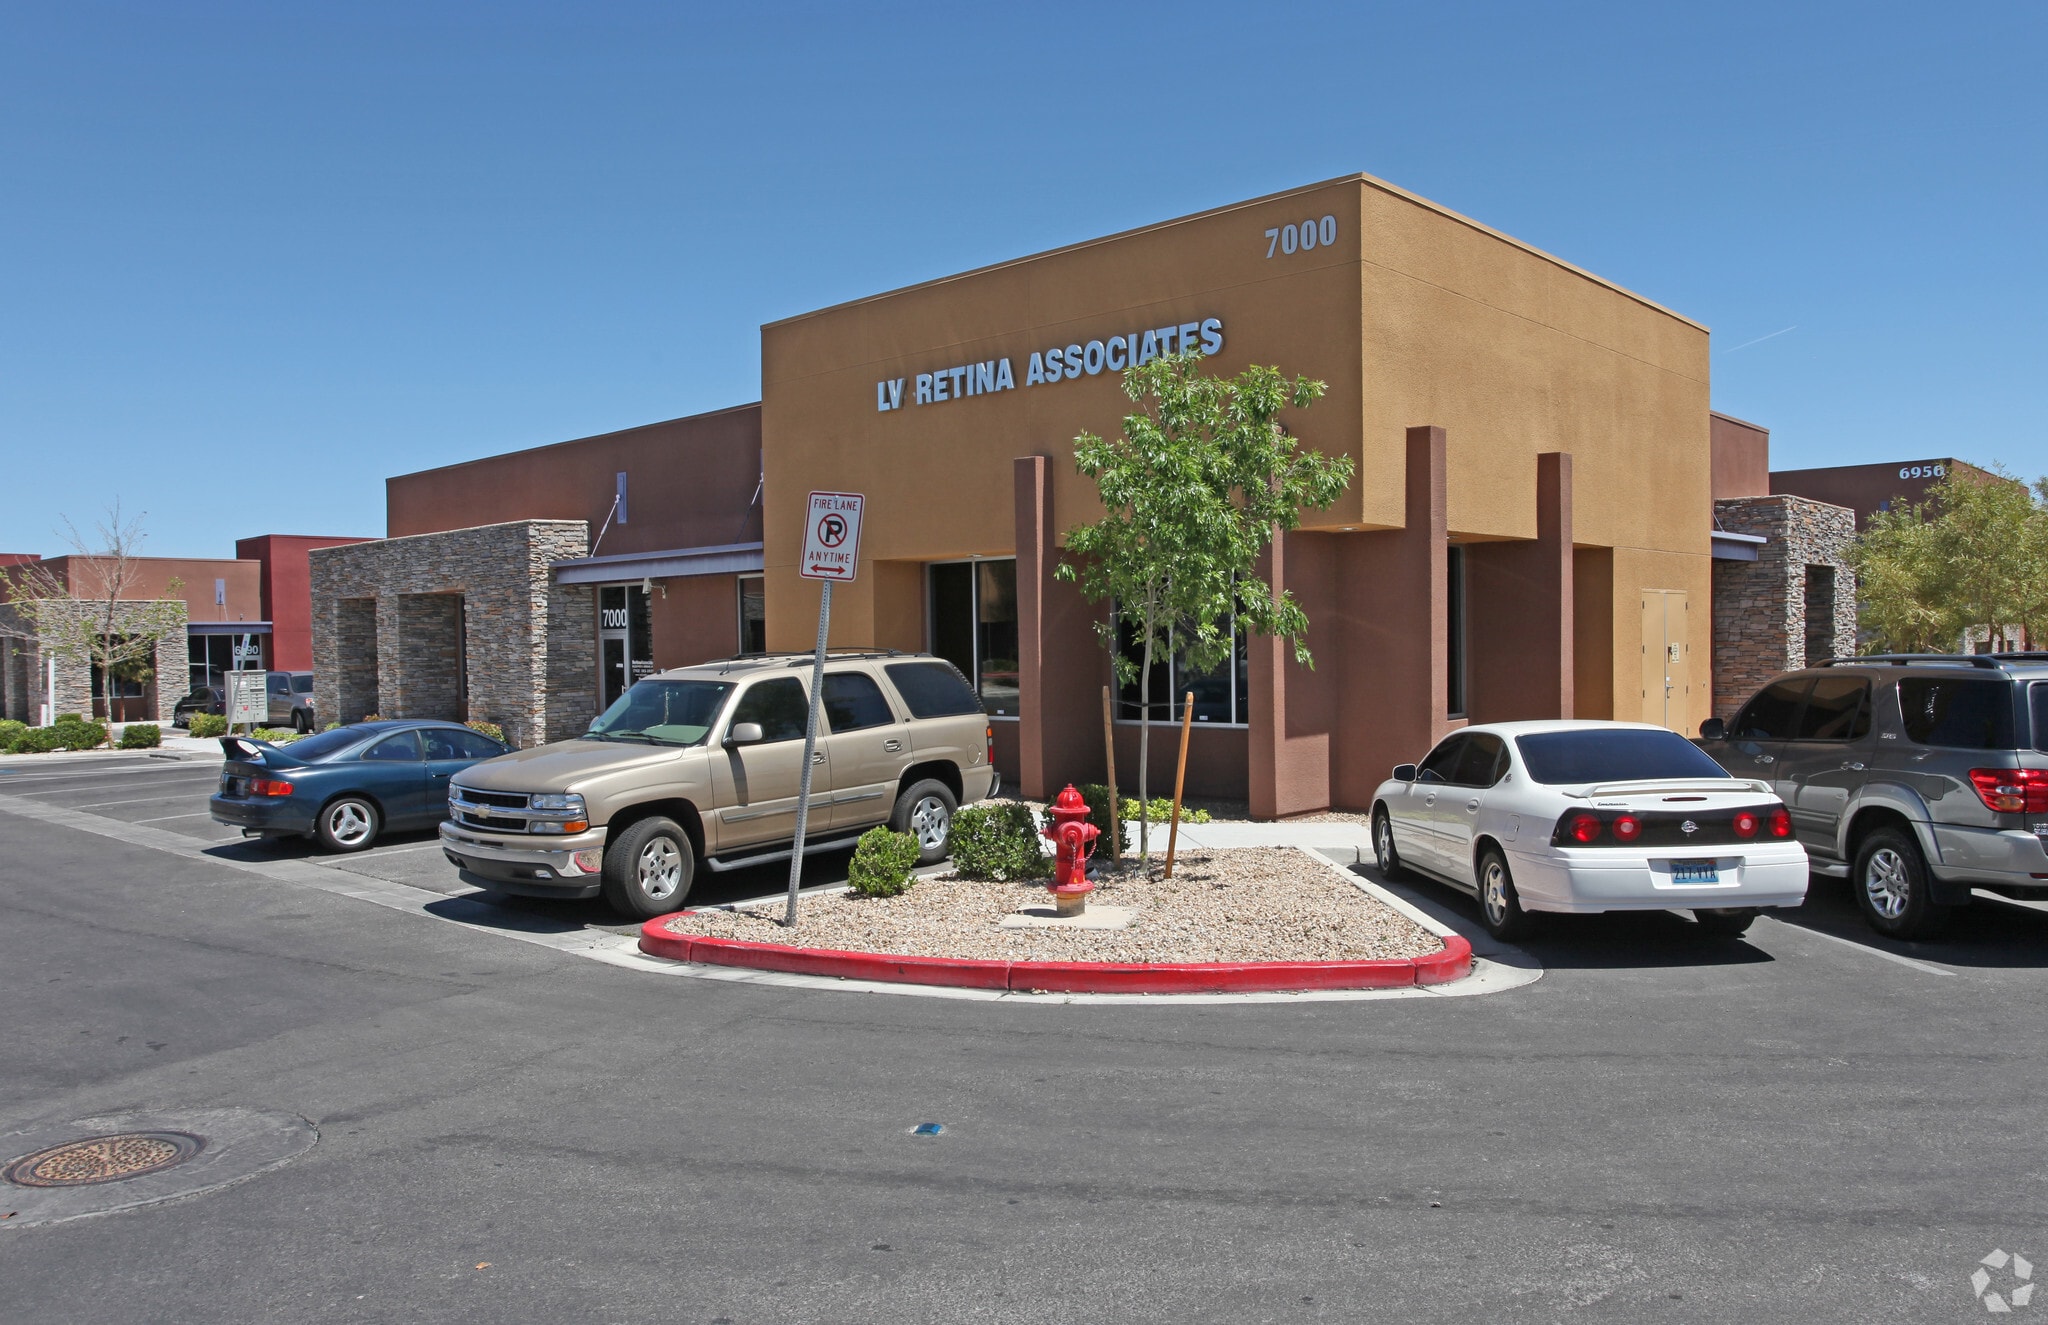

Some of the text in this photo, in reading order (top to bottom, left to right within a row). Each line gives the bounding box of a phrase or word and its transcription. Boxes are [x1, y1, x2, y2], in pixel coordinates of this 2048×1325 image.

[1265, 215, 1338, 259] 7000
[877, 317, 1224, 412] LV RETINA ASSOCIATES
[814, 499, 858, 511] FIRE LANE
[809, 551, 850, 564] ANYTIME
[602, 608, 627, 627] 7000
[235, 645, 259, 655] 690
